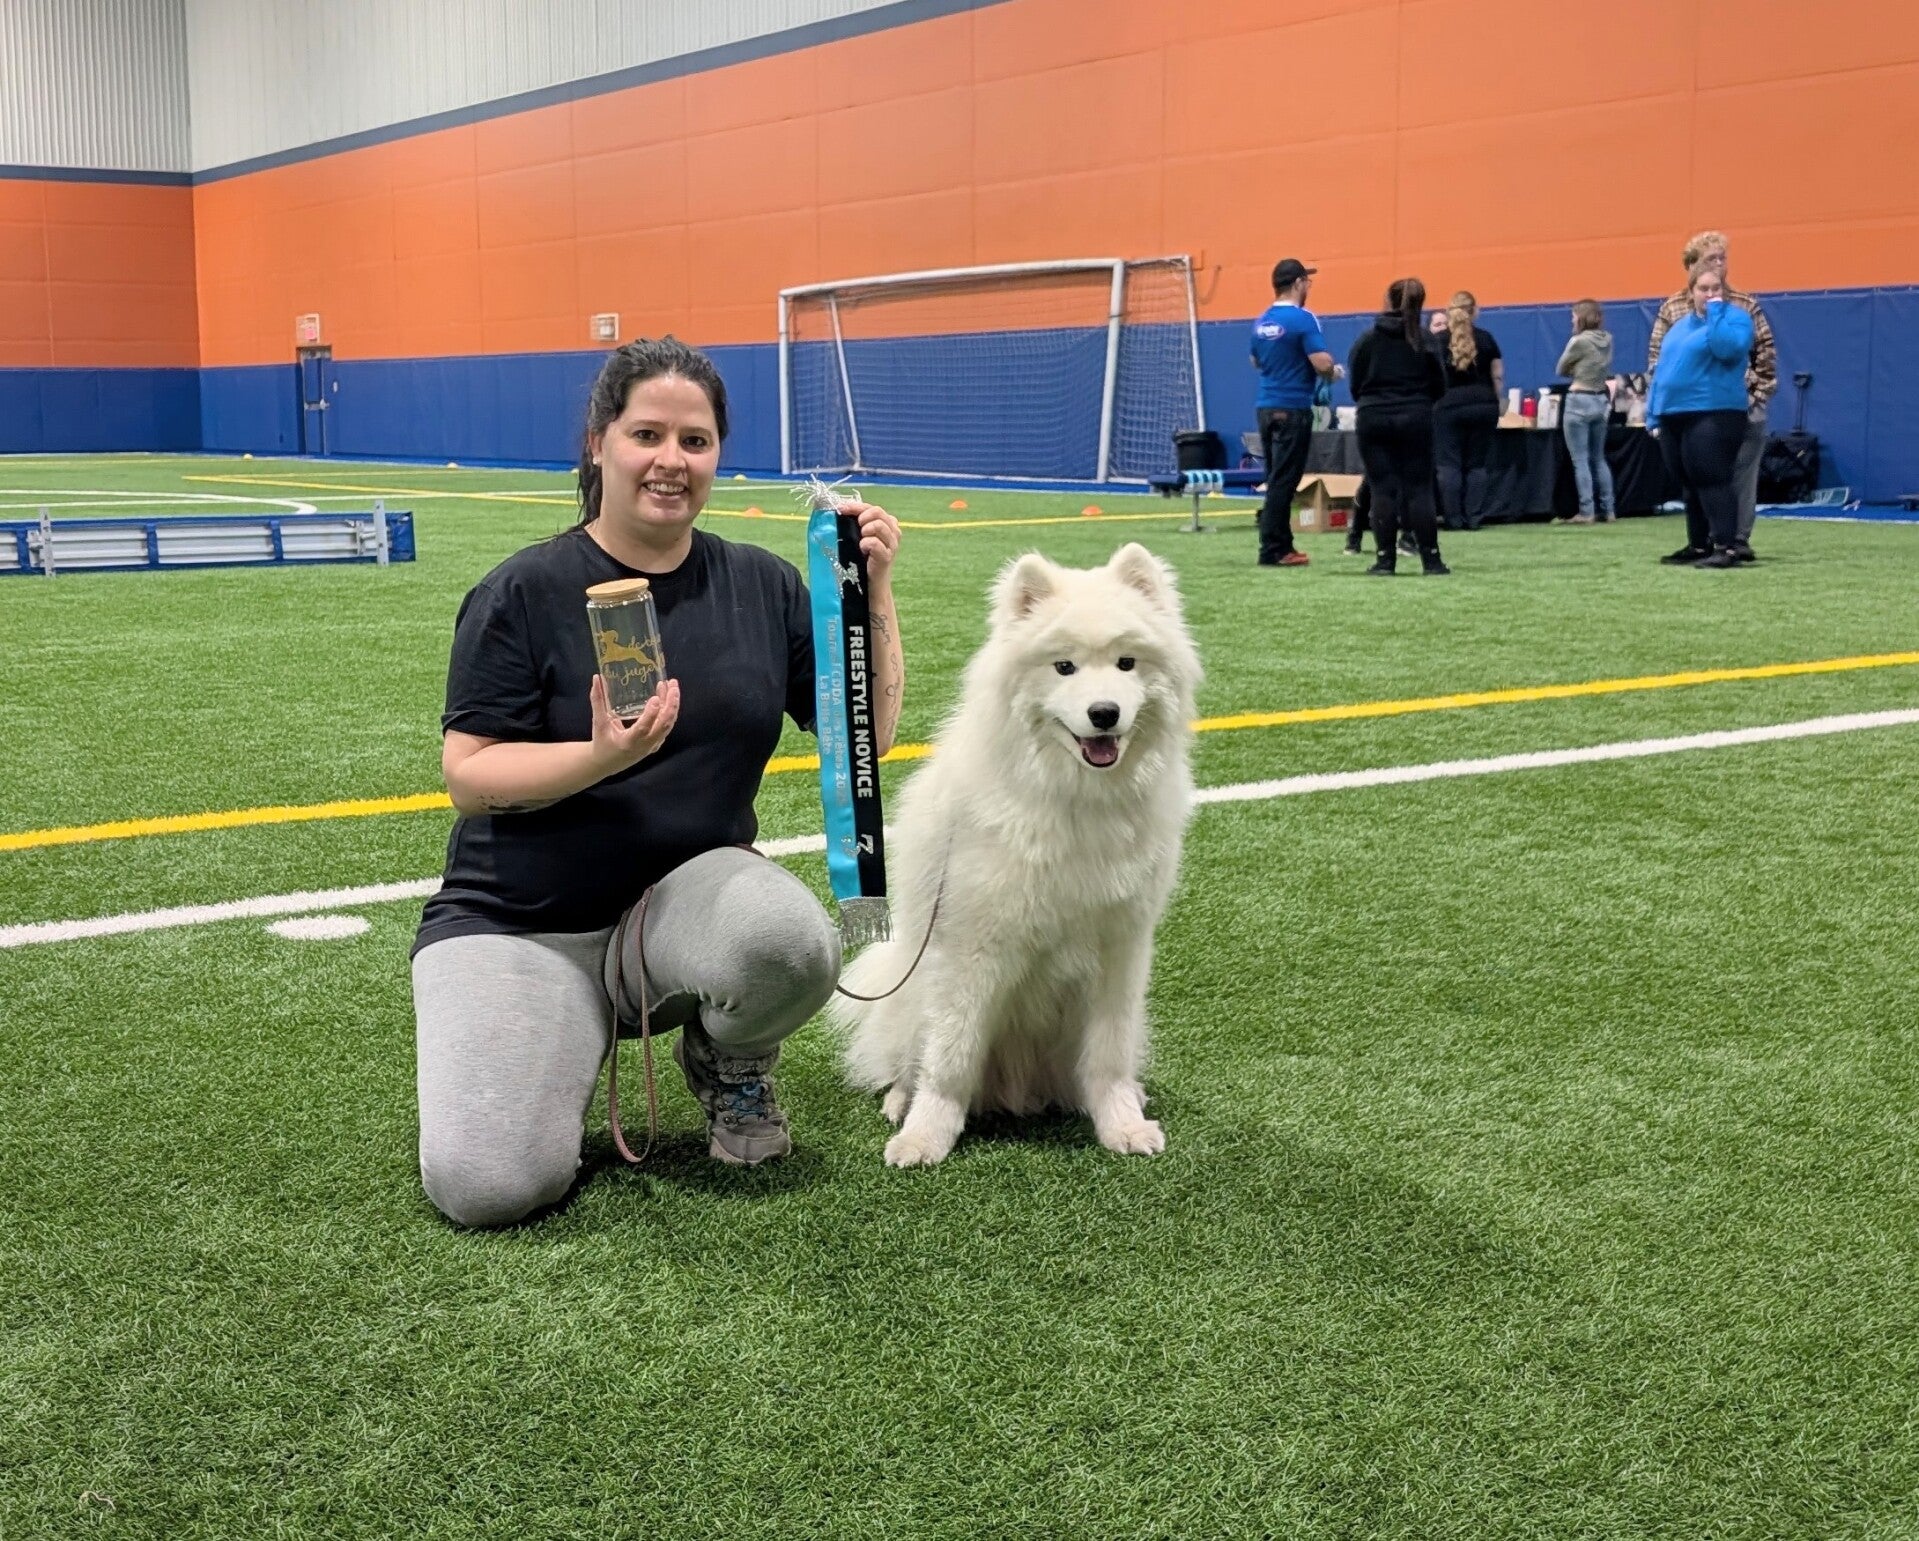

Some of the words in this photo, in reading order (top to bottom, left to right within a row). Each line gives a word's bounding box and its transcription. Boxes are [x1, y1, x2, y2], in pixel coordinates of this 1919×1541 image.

[819, 675, 830, 690] La
[849, 625, 868, 725] FREESTYLE
[854, 729, 873, 798] NOVICE
